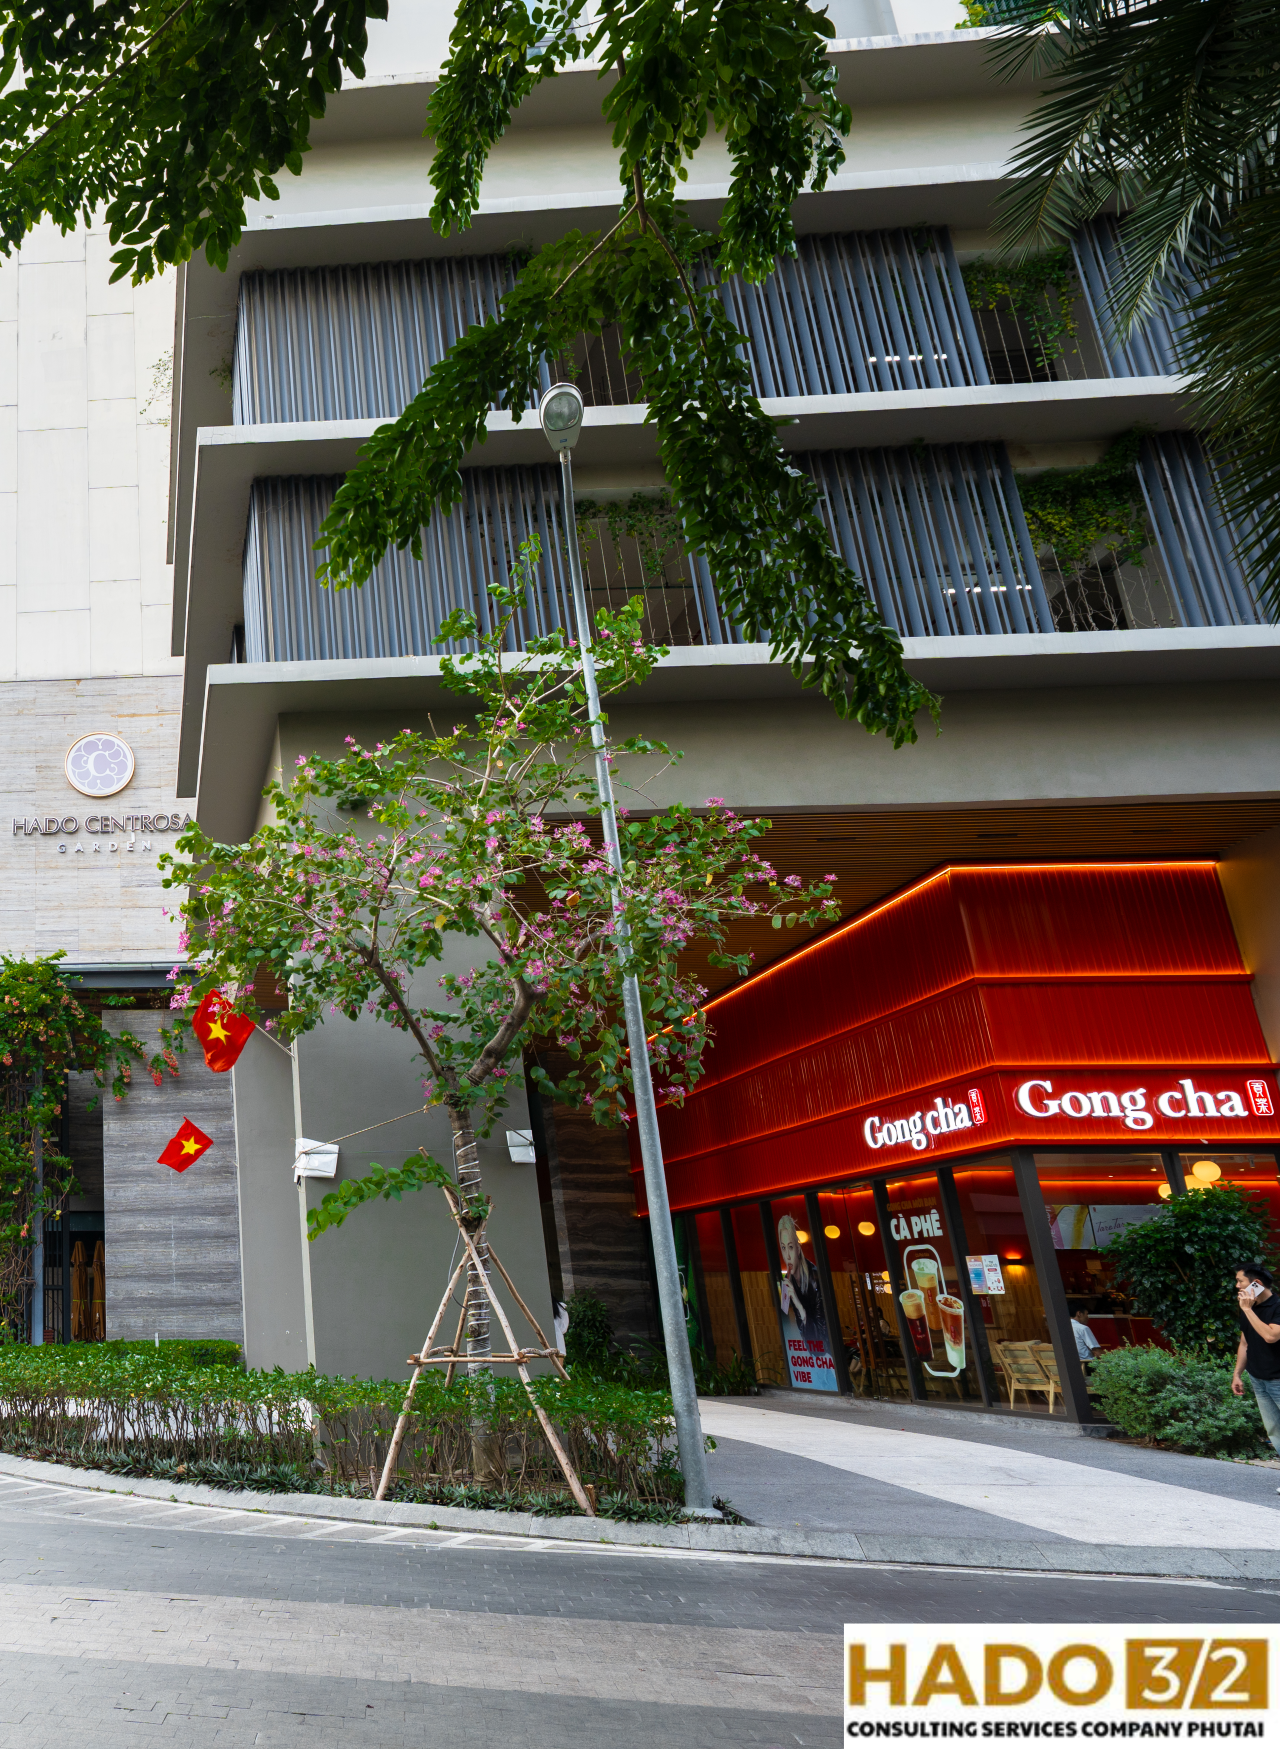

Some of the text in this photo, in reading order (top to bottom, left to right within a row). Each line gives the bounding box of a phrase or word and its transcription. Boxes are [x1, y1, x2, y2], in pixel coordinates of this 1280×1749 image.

[12, 813, 193, 835] HADO CENTROSA
[57, 840, 152, 853] GARDEN
[1018, 1079, 1248, 1130] Gong cha
[864, 1097, 972, 1150] Gong cha
[890, 1209, 943, 1240] CÀ PHÊ
[788, 1339, 825, 1352] FEEL THE
[791, 1356, 835, 1370] GONG CHA
[793, 1370, 812, 1383] VIBE
